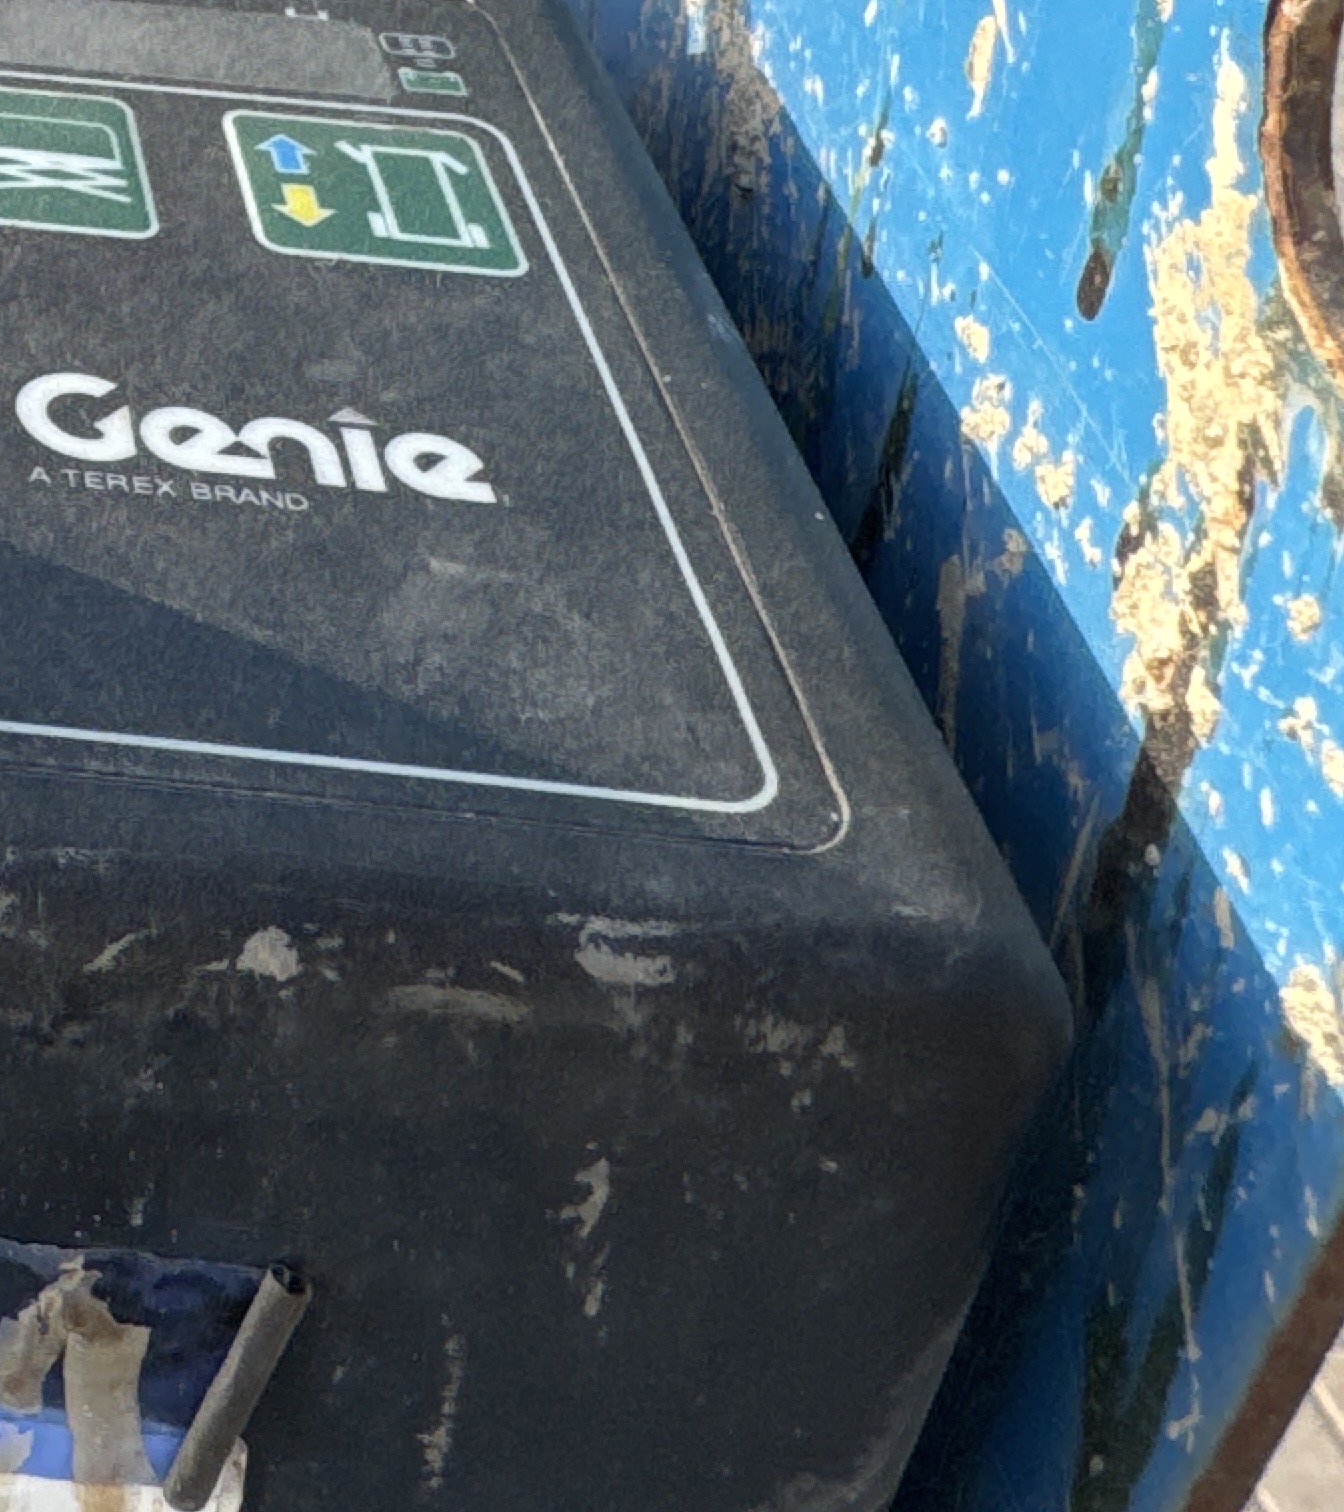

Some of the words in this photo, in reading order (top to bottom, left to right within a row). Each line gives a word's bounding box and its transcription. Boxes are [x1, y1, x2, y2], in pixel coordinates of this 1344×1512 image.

[14, 371, 498, 504] Genie
[27, 466, 52, 484] A
[61, 467, 174, 499] TEREX
[191, 482, 310, 512] BRAND
